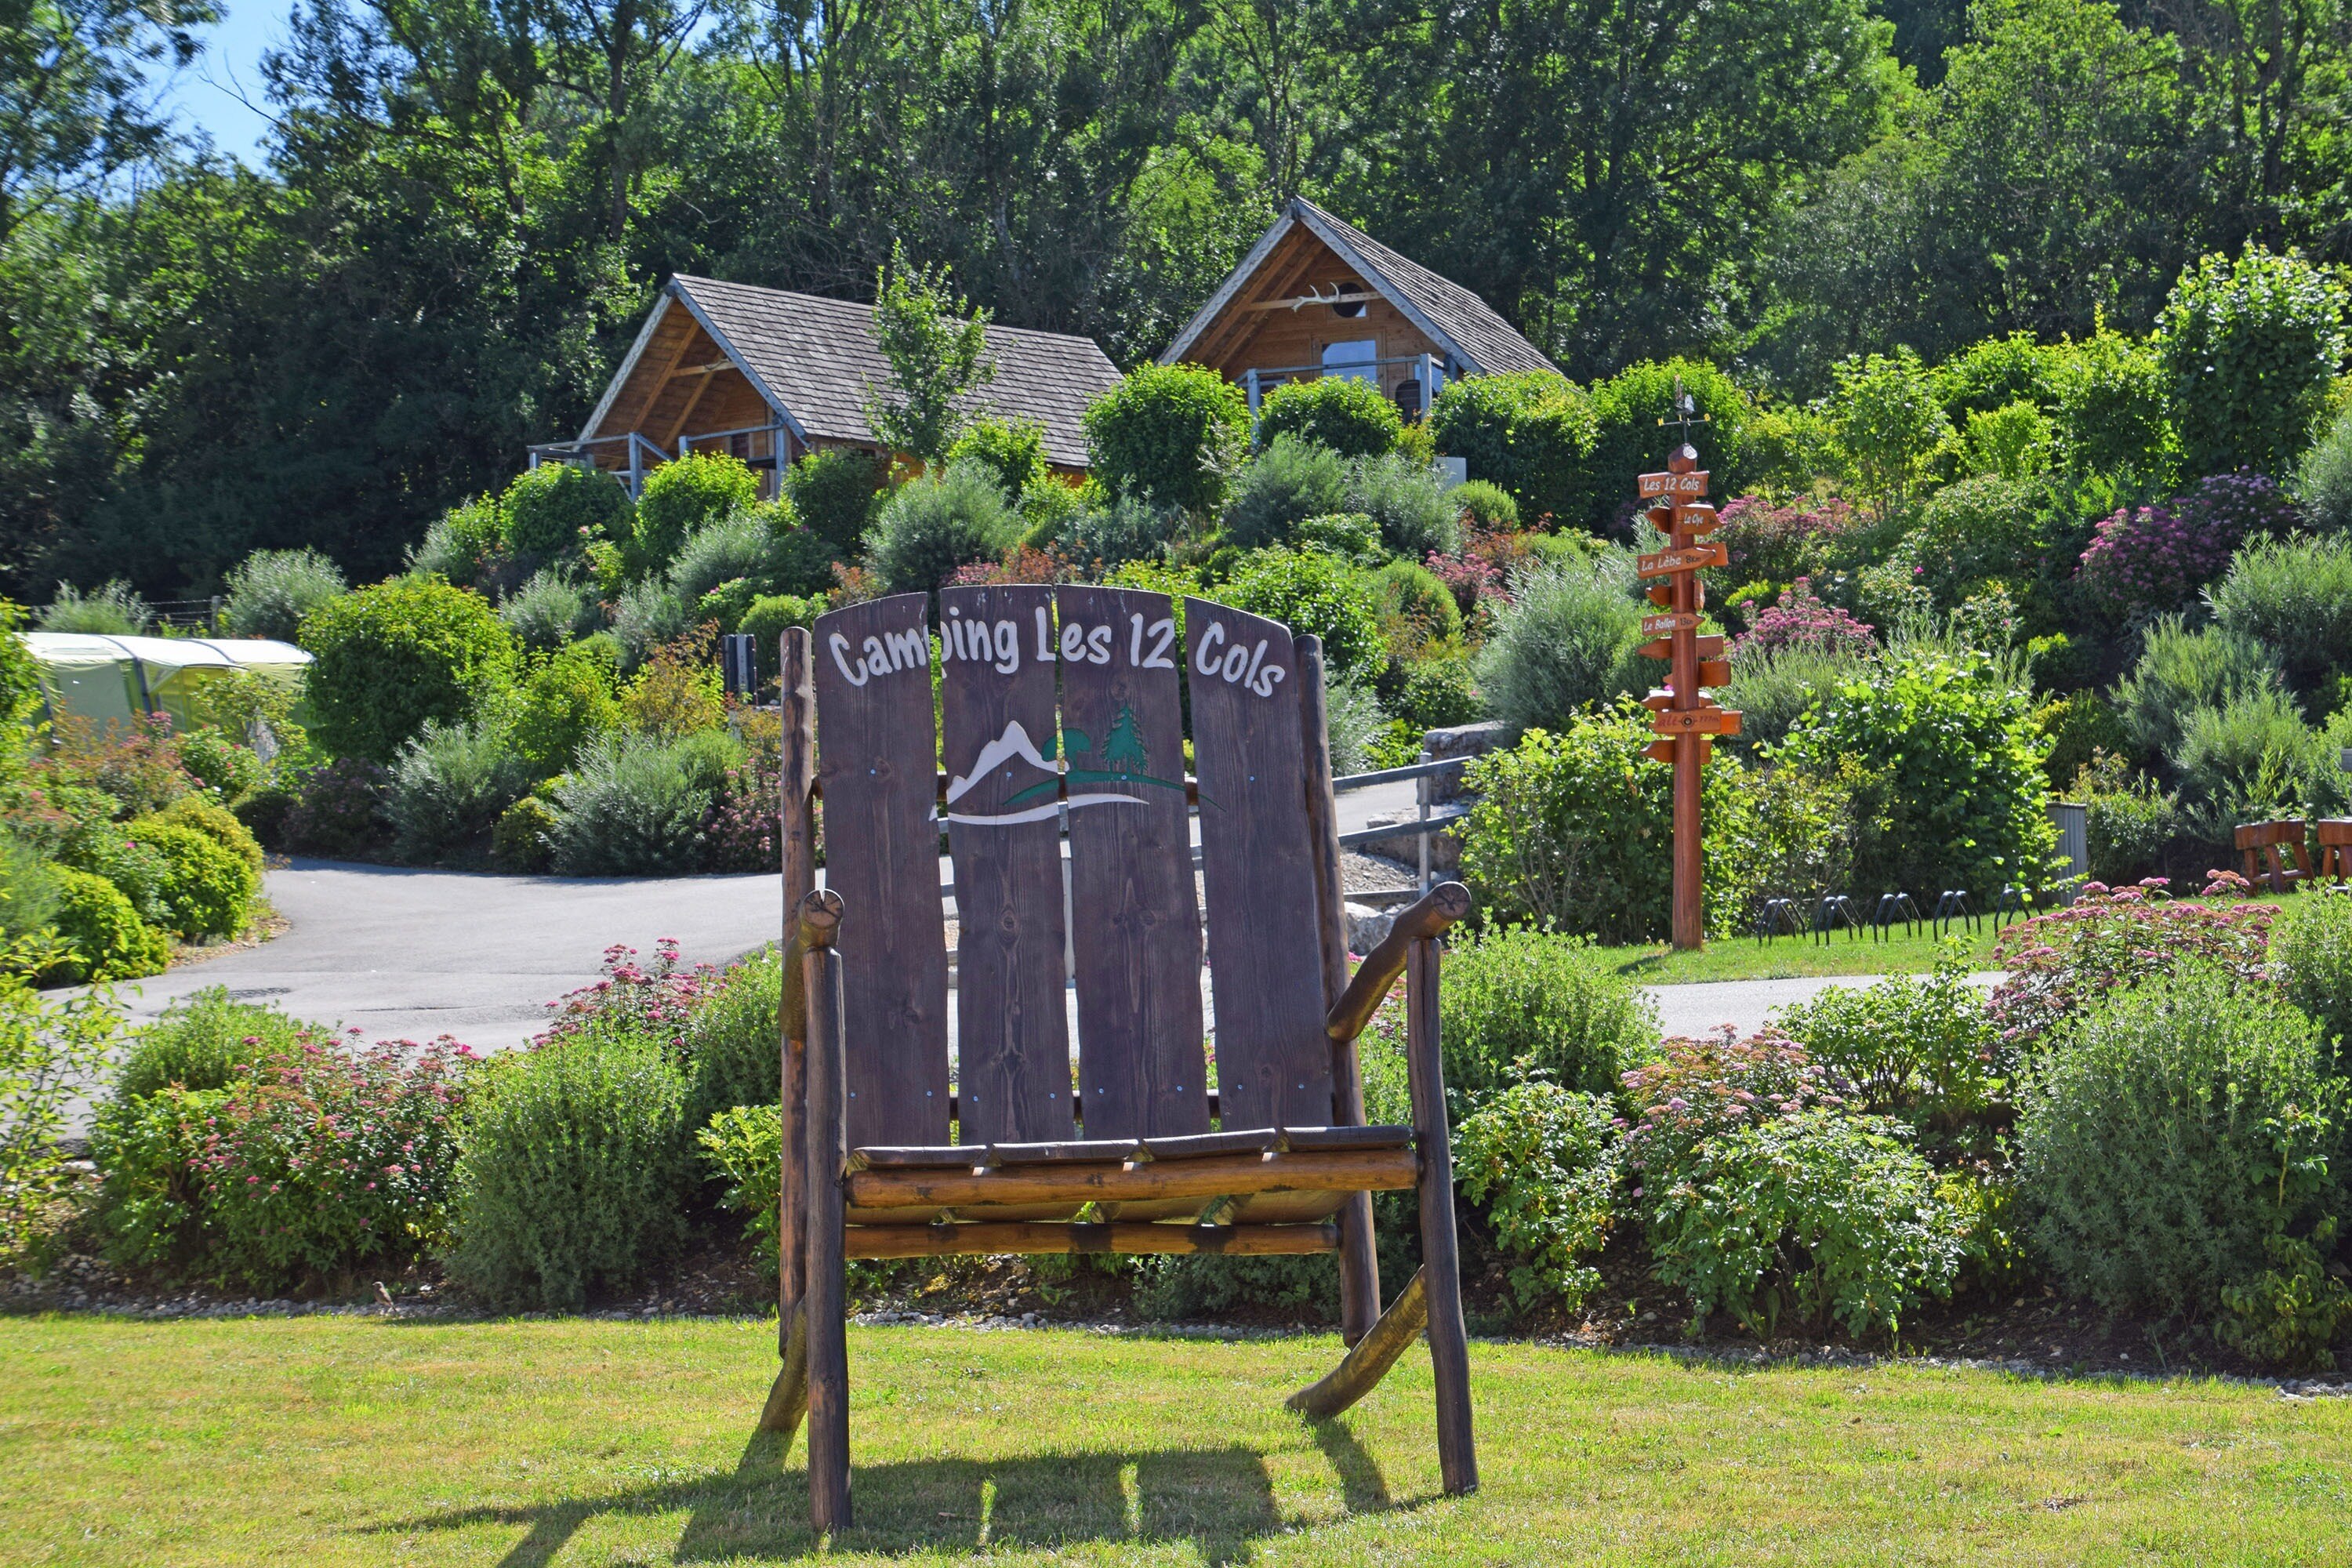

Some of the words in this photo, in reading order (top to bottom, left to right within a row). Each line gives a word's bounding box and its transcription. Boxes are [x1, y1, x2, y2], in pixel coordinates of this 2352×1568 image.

[1643, 477, 1661, 491] Les
[1664, 477, 1677, 491] 12
[1680, 477, 1700, 492] Cols
[1642, 561, 1653, 572] La
[1657, 554, 1682, 568] Lèbe
[1035, 606, 1112, 666] Les
[1130, 612, 1176, 670] 12
[1195, 621, 1286, 698] Cols
